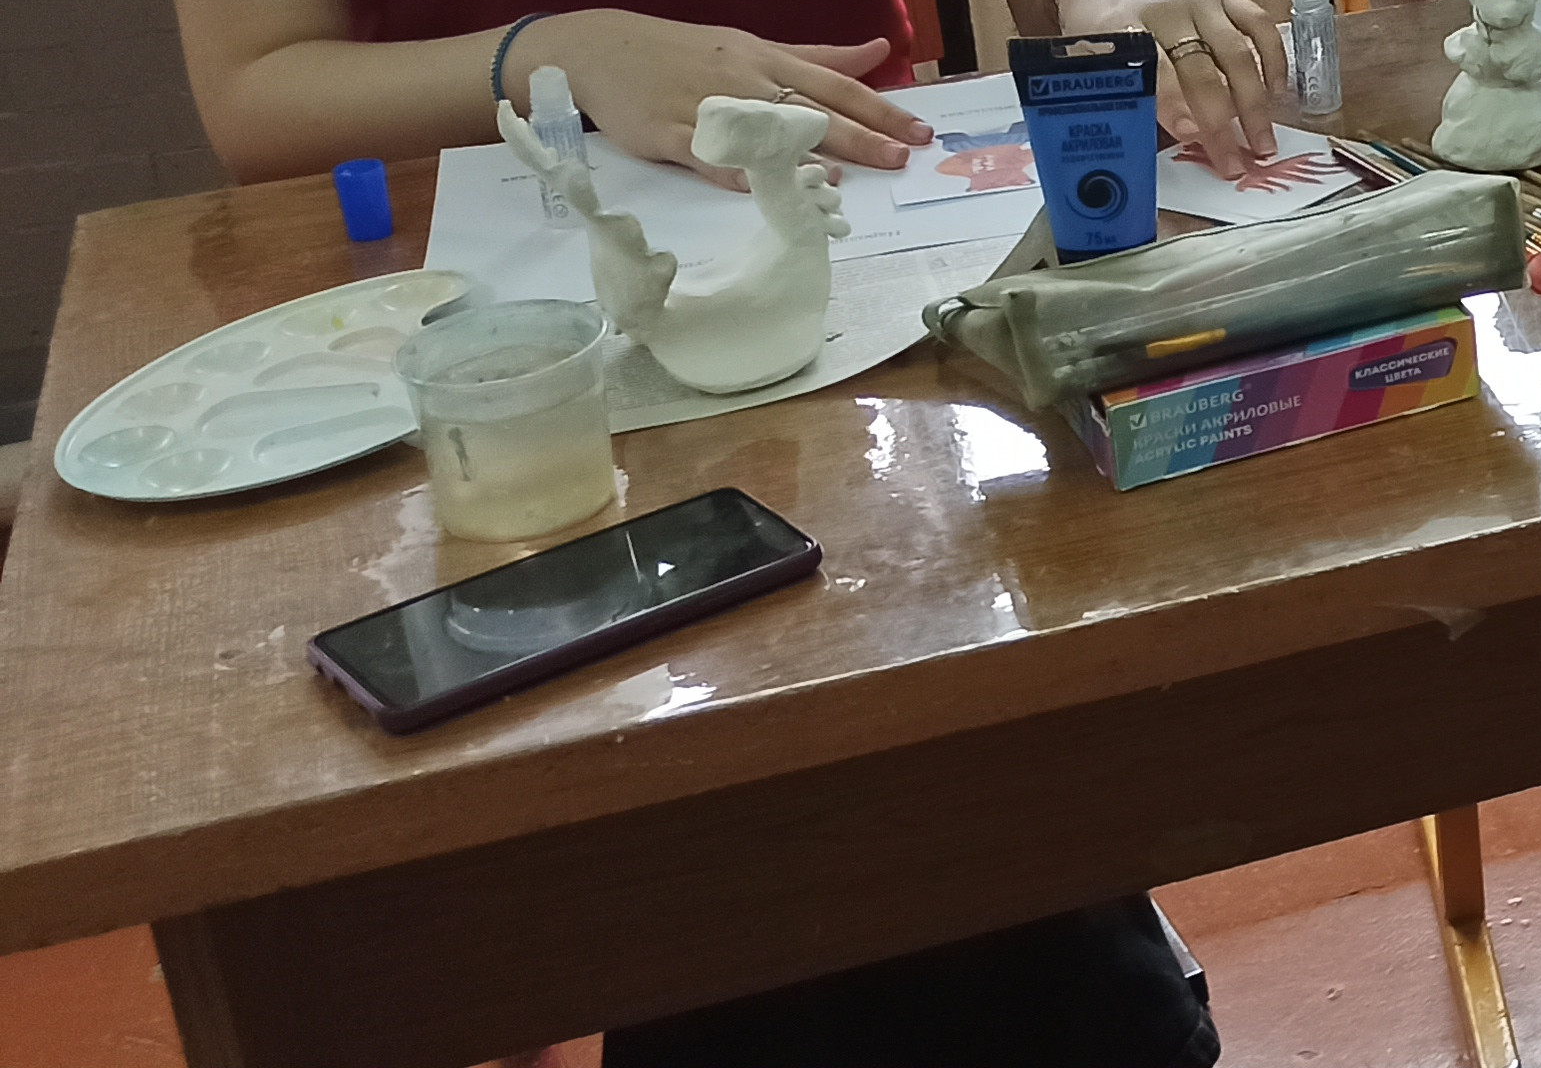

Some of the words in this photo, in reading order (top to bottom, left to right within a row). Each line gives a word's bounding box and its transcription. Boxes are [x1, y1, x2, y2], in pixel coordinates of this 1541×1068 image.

[1051, 75, 1136, 93] BRAUBERG
[1068, 122, 1114, 138] КРАСКА
[1354, 347, 1450, 380] КЛАССИЧЕСКИЕ
[1384, 367, 1422, 384] ЦВЕТА
[1133, 422, 1197, 450] КРАСКИ
[1201, 395, 1303, 430] АКРИЛОВЫЕ
[1150, 389, 1245, 424] BRAUBERG
[1136, 438, 1197, 465] ACRYLIC
[1200, 423, 1253, 447] PAINTS
